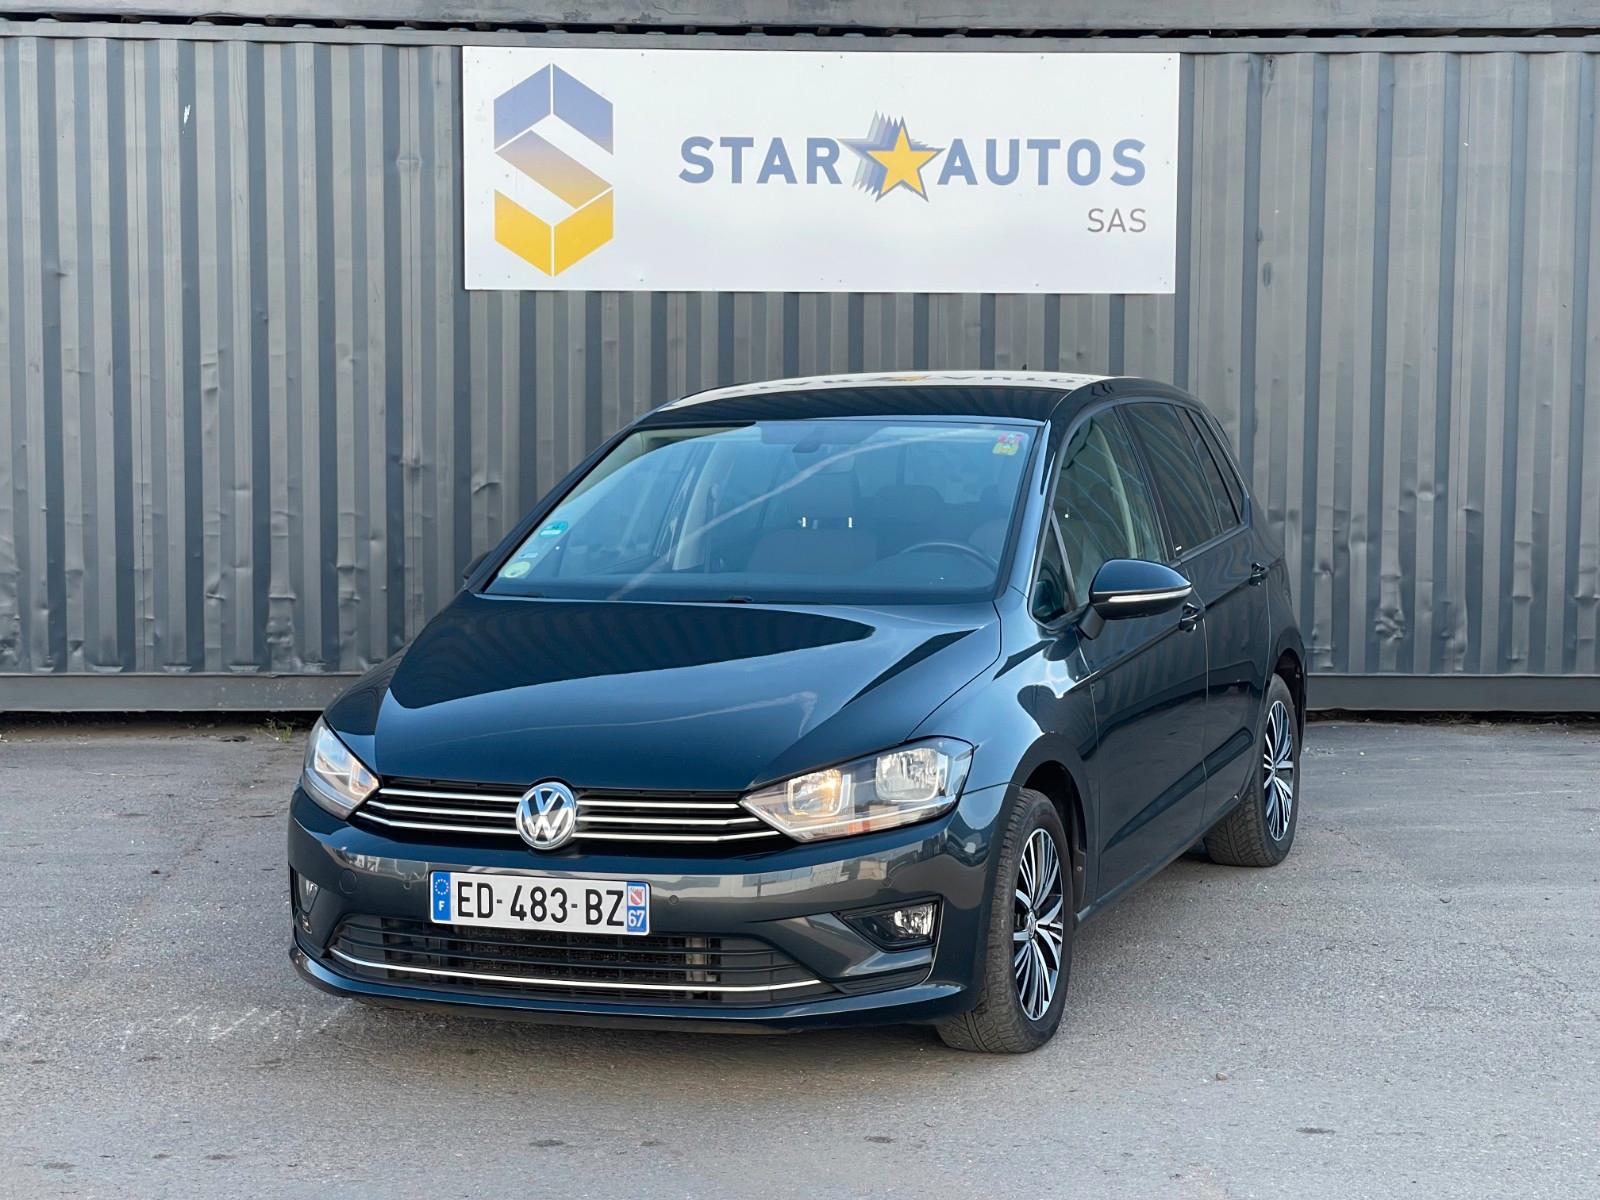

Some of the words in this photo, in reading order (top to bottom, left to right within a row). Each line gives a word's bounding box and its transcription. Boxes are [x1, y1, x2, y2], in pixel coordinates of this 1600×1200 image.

[679, 136, 842, 185] STAR
[936, 138, 1146, 187] AUTOS
[1087, 207, 1147, 234] SAS
[438, 900, 445, 911] F
[457, 881, 625, 927] ED-483-BZ
[627, 909, 645, 927] 67
